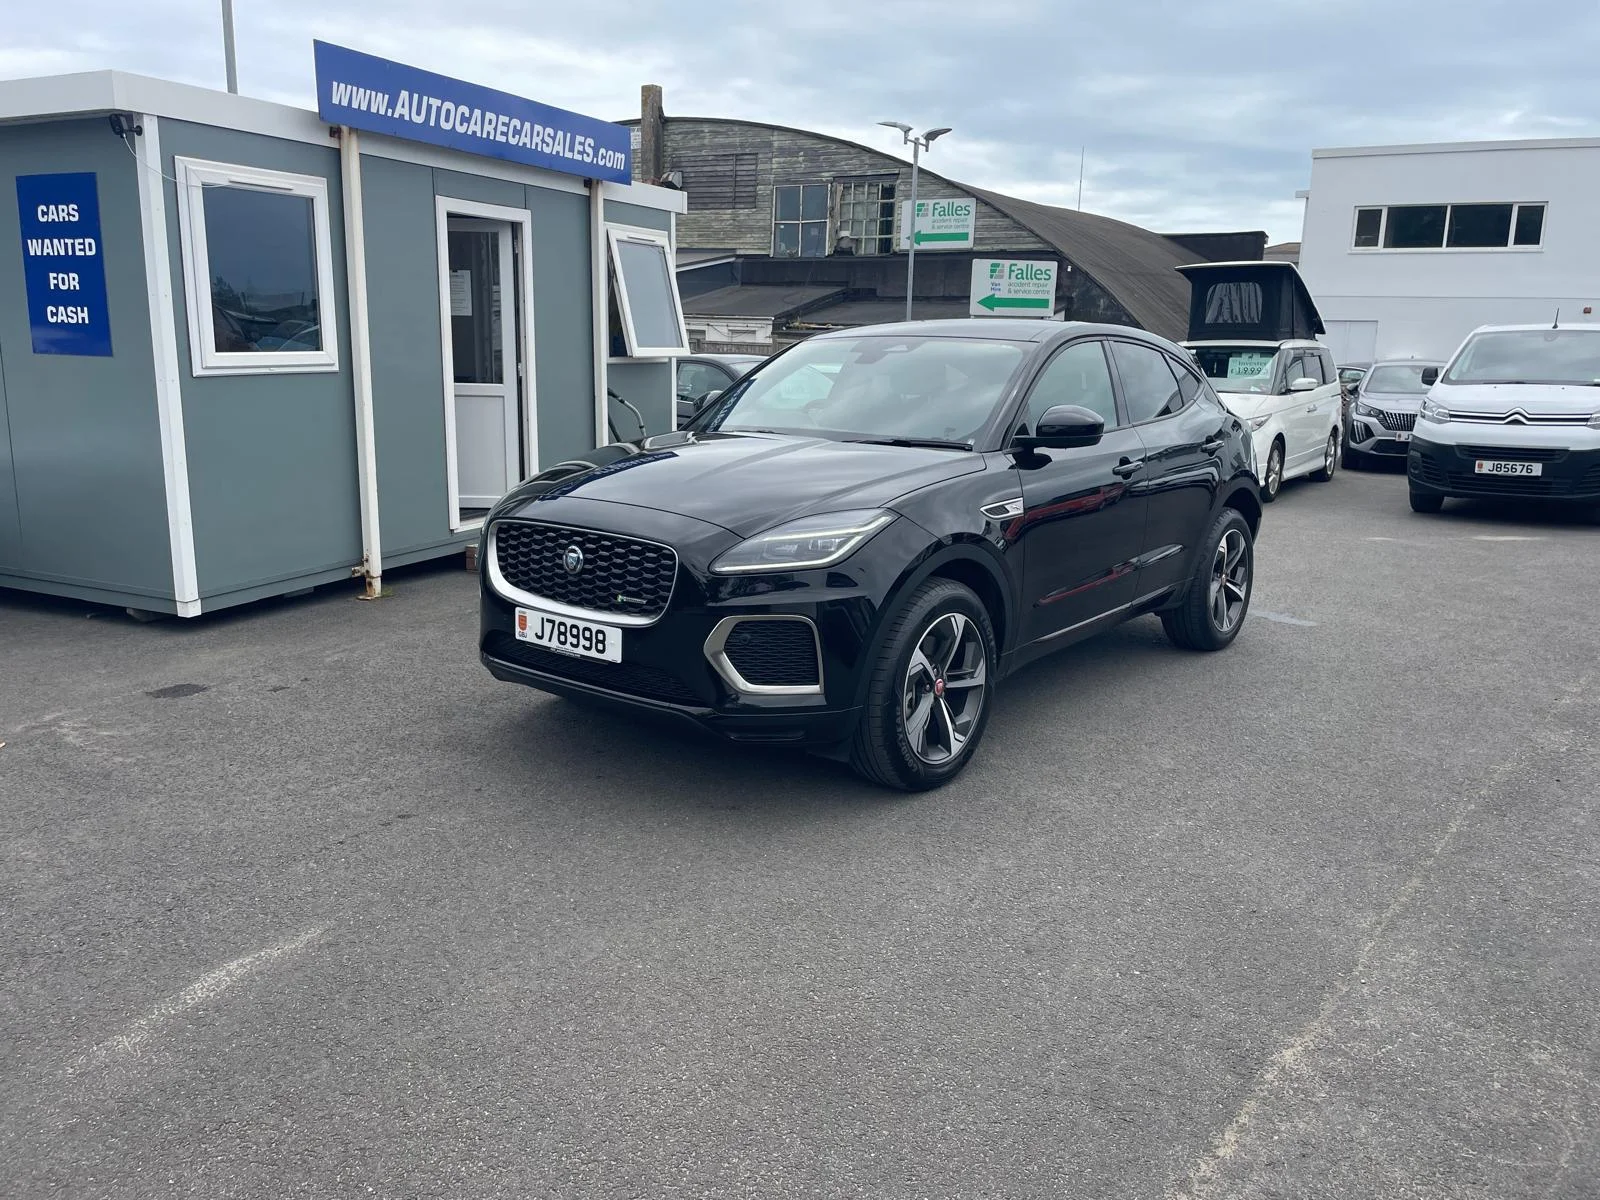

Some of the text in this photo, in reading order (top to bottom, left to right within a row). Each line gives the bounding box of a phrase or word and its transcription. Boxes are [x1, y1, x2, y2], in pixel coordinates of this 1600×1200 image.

[331, 81, 625, 171] www.AUTOCARECARSALES.com
[37, 203, 79, 222] CARS
[932, 201, 971, 217] Falles
[27, 238, 96, 256] WANTED
[48, 272, 80, 290] FOR
[1008, 263, 1052, 281] Falles
[46, 305, 89, 324] CASH
[1487, 462, 1533, 474] J85676
[534, 616, 607, 655] J78998
